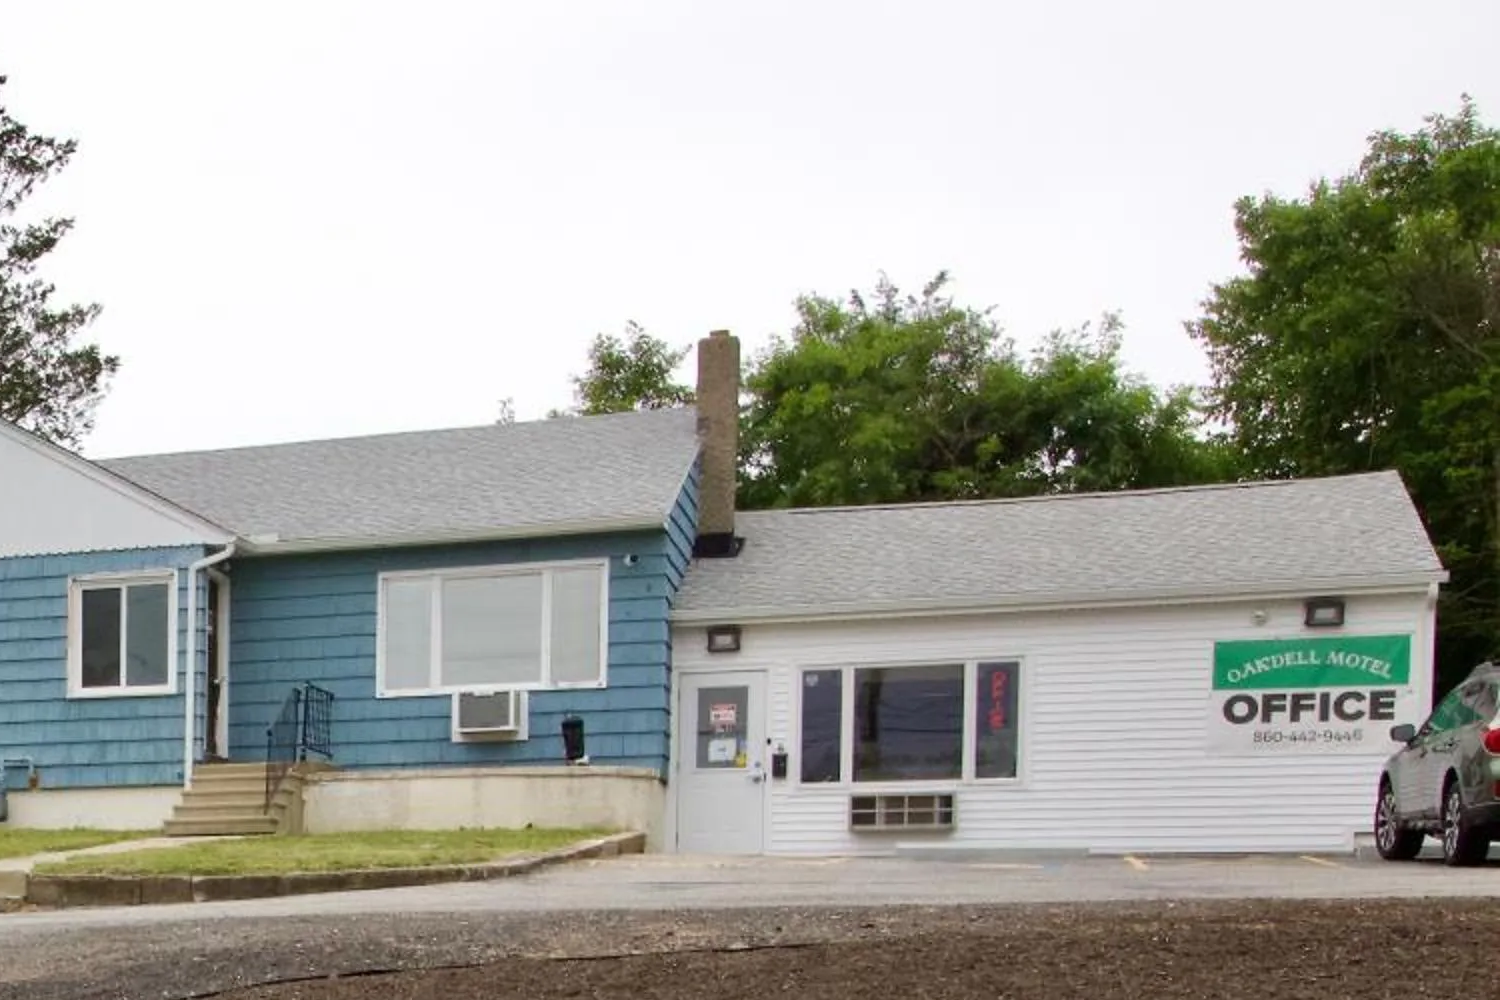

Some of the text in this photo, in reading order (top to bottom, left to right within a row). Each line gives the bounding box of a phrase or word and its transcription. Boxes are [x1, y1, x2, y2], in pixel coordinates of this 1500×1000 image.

[1228, 650, 1392, 683] OAKDELL MOTEL
[1223, 690, 1396, 724] OFFICE
